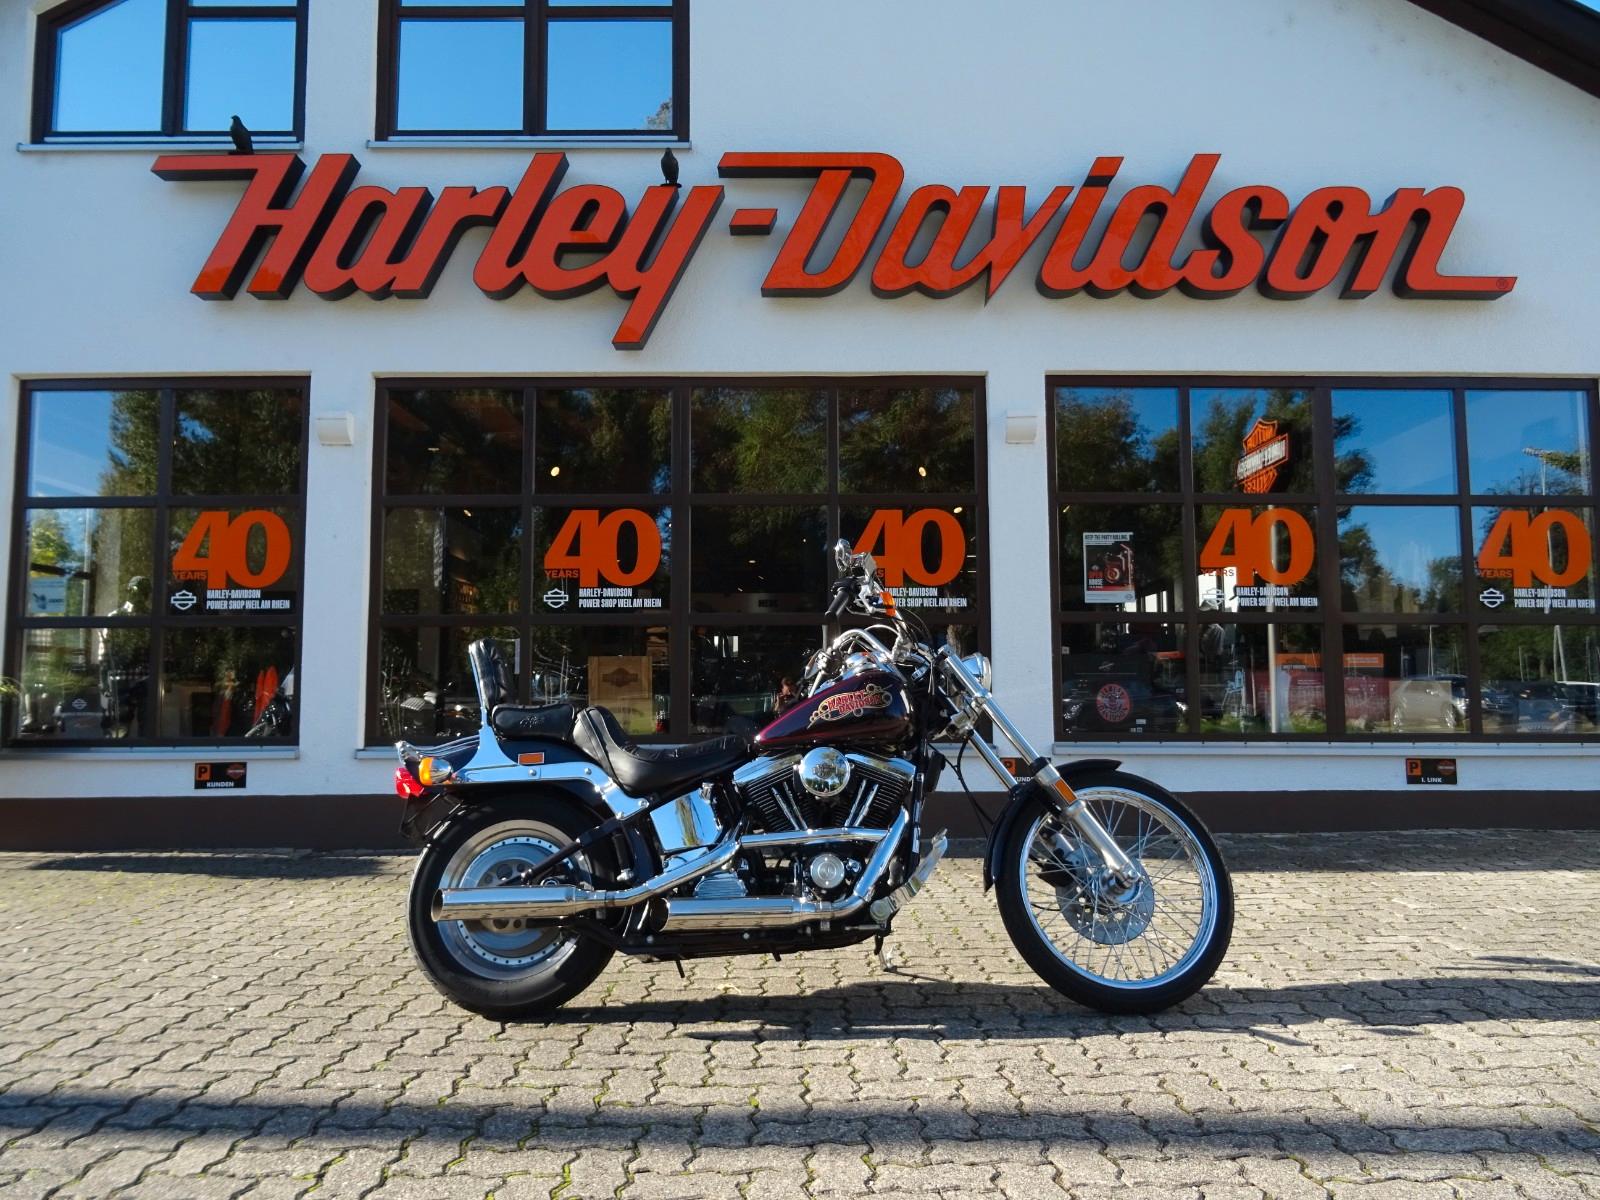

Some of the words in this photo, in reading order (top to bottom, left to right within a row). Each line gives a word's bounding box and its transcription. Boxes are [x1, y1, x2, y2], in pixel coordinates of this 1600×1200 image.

[151, 151, 1517, 350] Harley-Davidson
[172, 510, 292, 589] 40
[544, 508, 662, 588] 40
[852, 508, 966, 588] 40
[1200, 508, 1315, 587] 40
[1477, 509, 1592, 588] 40
[173, 571, 208, 580] YEARS
[544, 570, 578, 579] YEARS
[1200, 568, 1235, 576] YEARS
[1480, 570, 1512, 578] YEARS
[206, 590, 260, 599] HARLEY-DAVIDSON
[579, 588, 632, 598] HARLEY-DAVIDSON
[1236, 587, 1288, 596] HARLEY-DAVIDSON
[1514, 588, 1566, 598] HARLEY-DAVIDSON
[206, 600, 228, 610] POWER
[229, 600, 245, 609] SHOP
[246, 600, 260, 609] WEIL
[261, 600, 270, 609] AM
[272, 600, 290, 609] RHEIN
[579, 599, 600, 608] POWER
[601, 599, 617, 608] SHOP
[618, 598, 632, 608] WEIL
[633, 598, 642, 608] AM
[644, 598, 662, 608] RHEIN
[907, 598, 922, 607] SHOP
[924, 598, 938, 607] WEIL
[939, 598, 948, 607] AM
[950, 598, 968, 607] RHEIN
[198, 765, 208, 778] P
[1410, 761, 1419, 774] P
